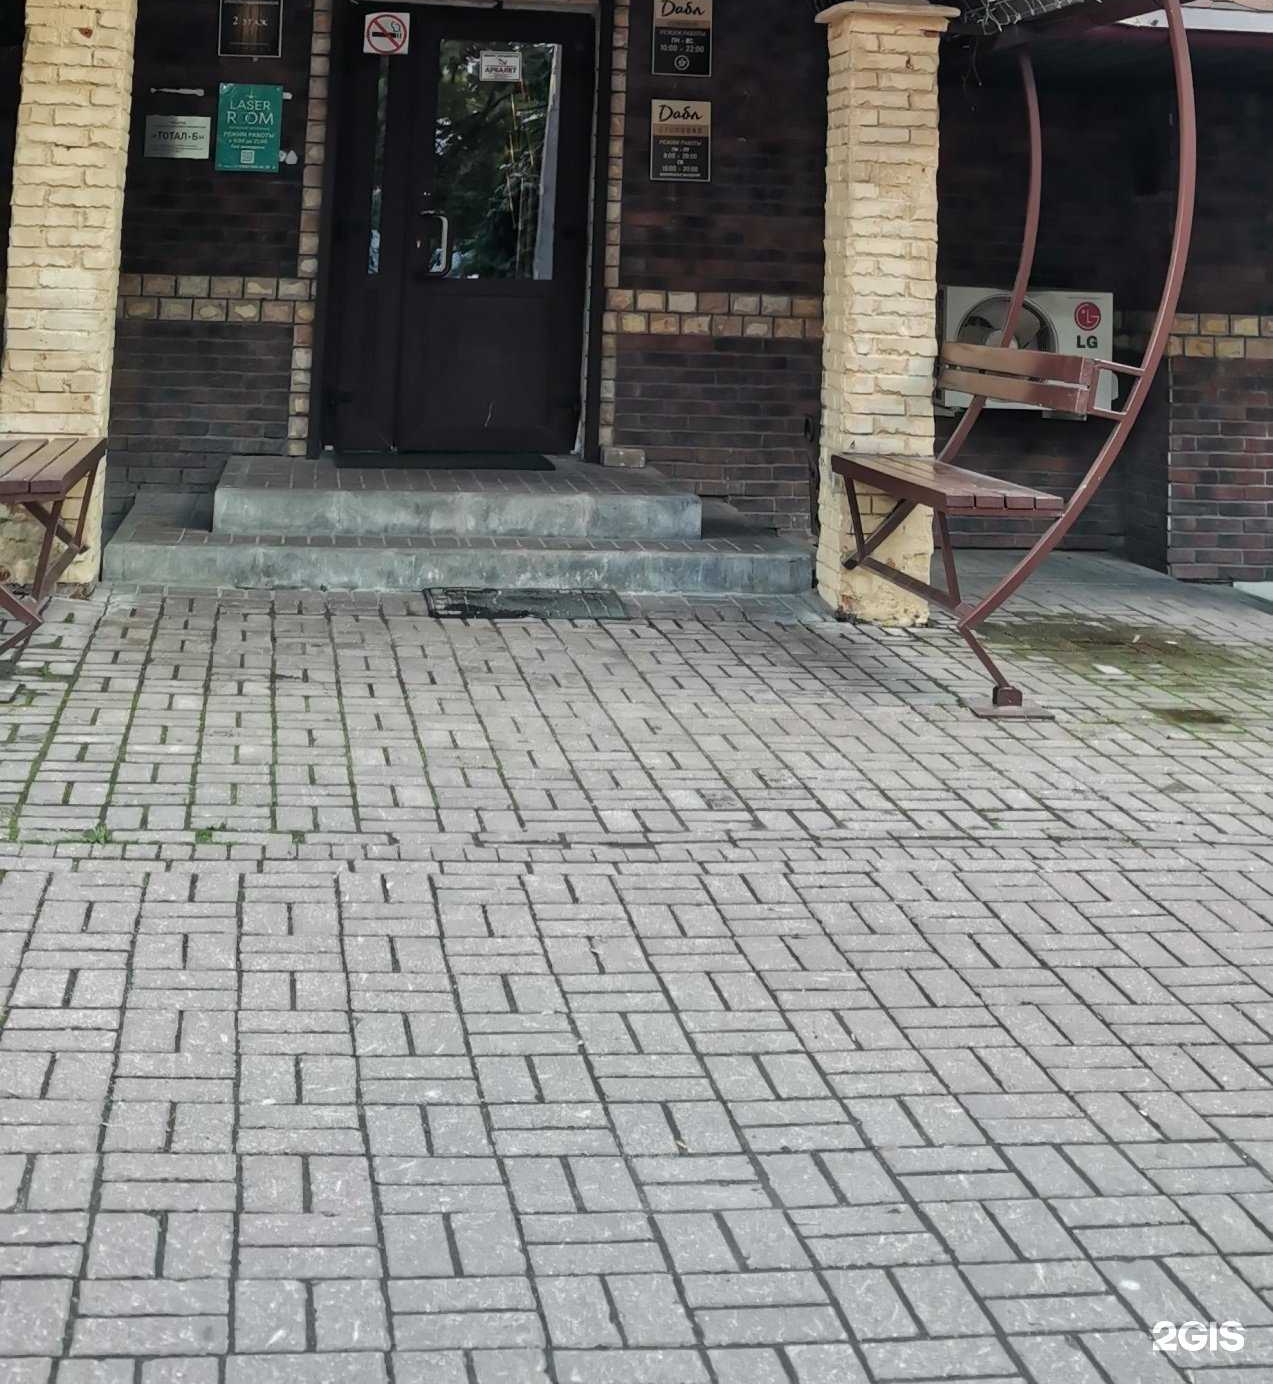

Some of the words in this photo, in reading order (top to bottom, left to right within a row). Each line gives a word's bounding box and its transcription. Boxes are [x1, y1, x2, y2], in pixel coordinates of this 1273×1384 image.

[660, 0, 705, 17] Дабл
[232, 15, 239, 26] 2
[229, 99, 271, 111] LASER
[658, 104, 703, 122] Дабл
[1076, 335, 1098, 349] LG
